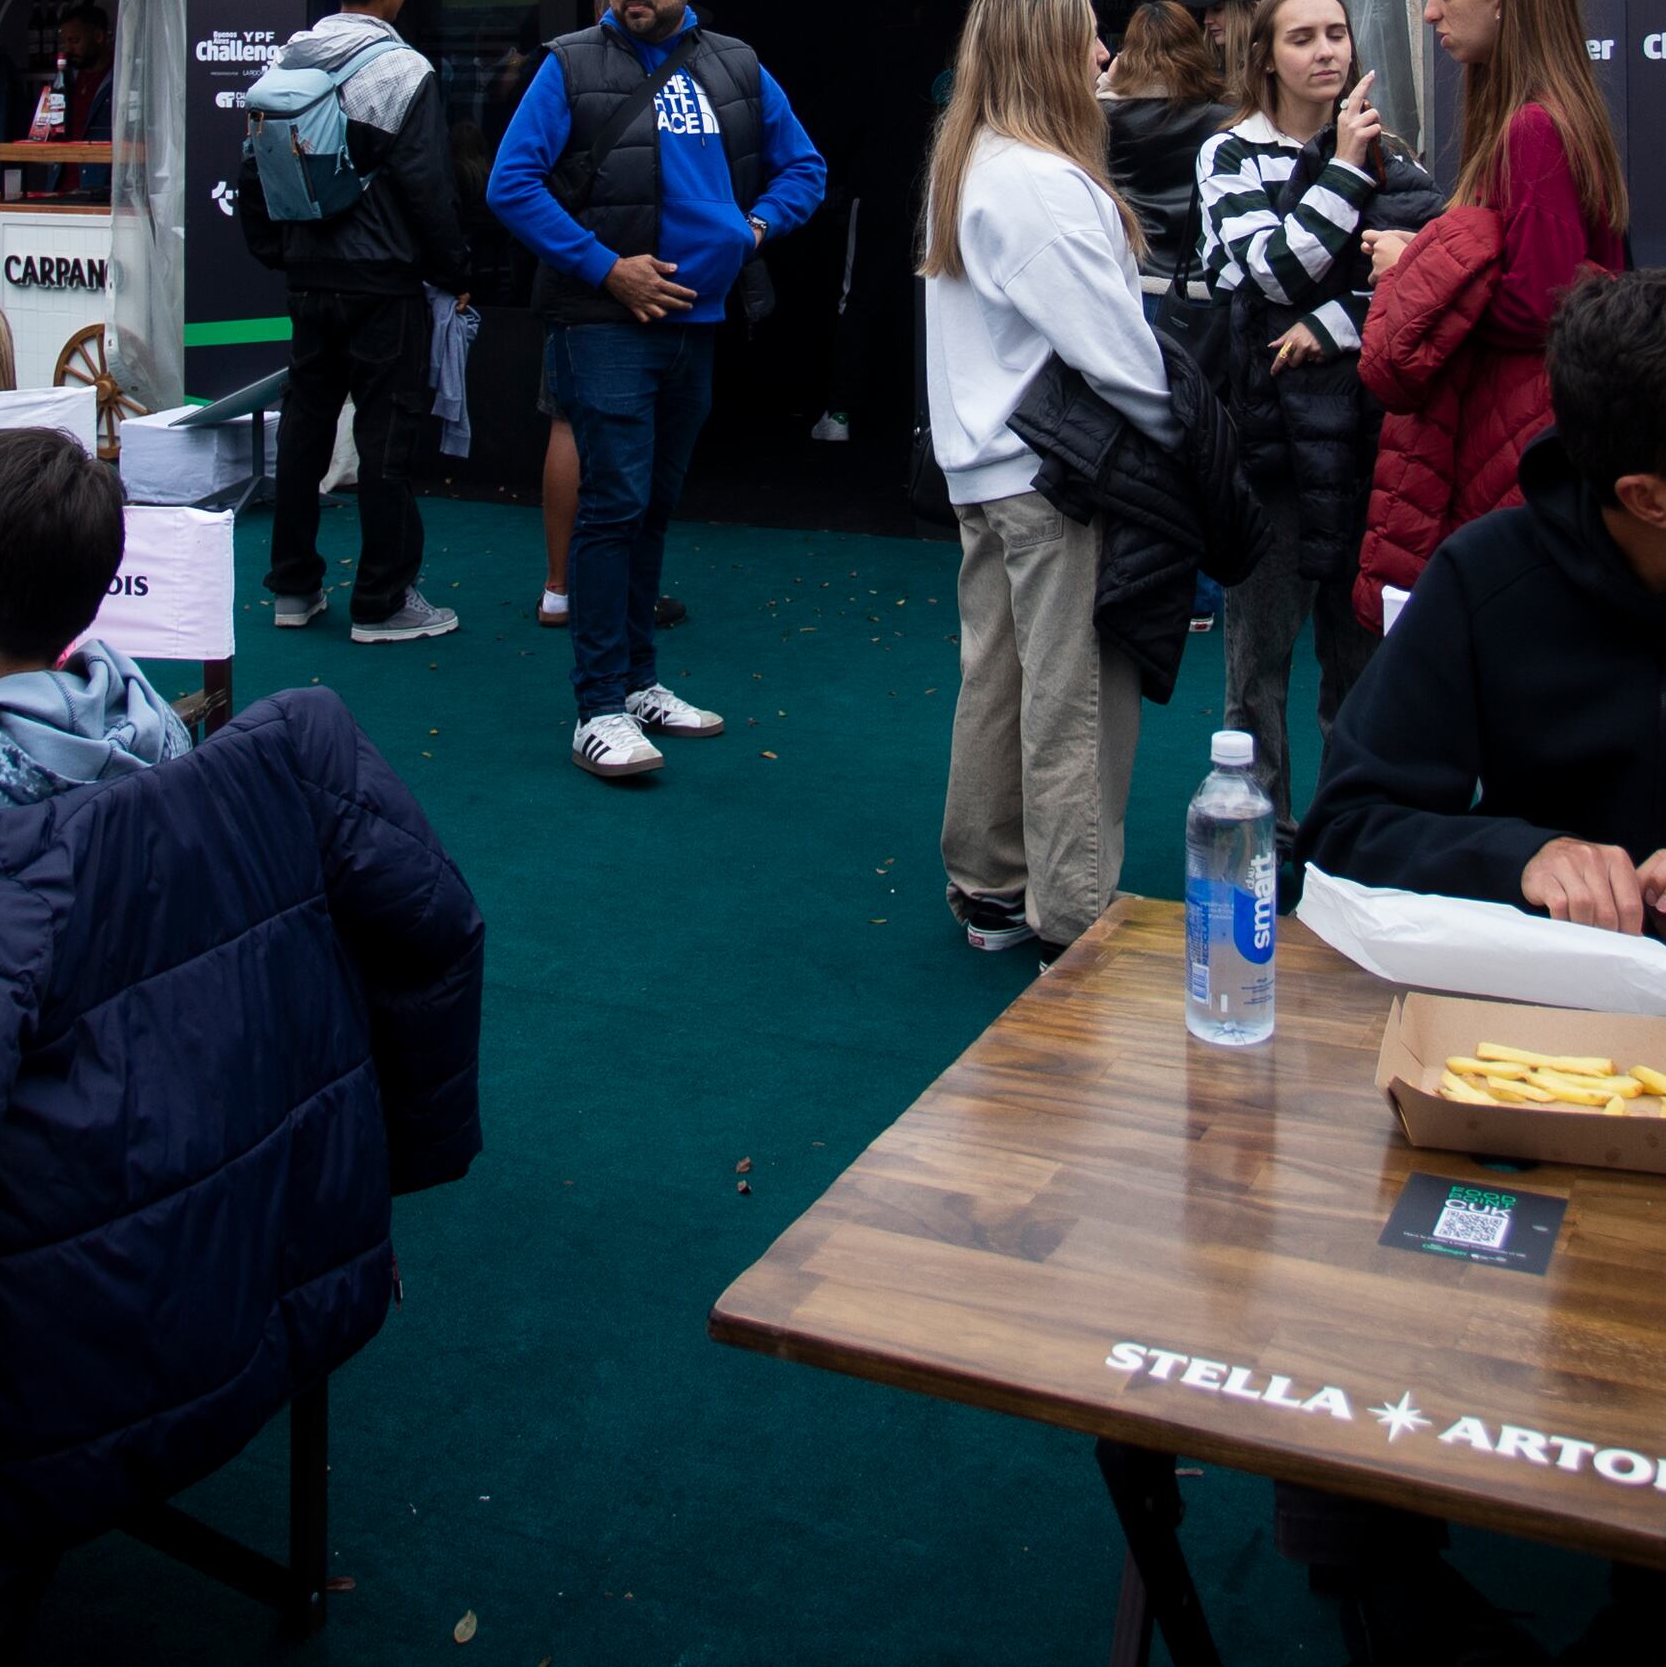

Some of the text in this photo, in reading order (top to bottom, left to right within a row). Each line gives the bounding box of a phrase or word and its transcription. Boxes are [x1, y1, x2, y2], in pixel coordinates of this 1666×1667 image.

[243, 32, 275, 42] YPF
[196, 40, 280, 63] Challeng
[5, 255, 110, 290] CARPAN
[1251, 852, 1274, 950] smart
[1448, 1192, 1516, 1209] POINT
[1451, 1186, 1517, 1203] FOOD
[1445, 1199, 1513, 1219] CUK
[1104, 1342, 1353, 1421] STELLA
